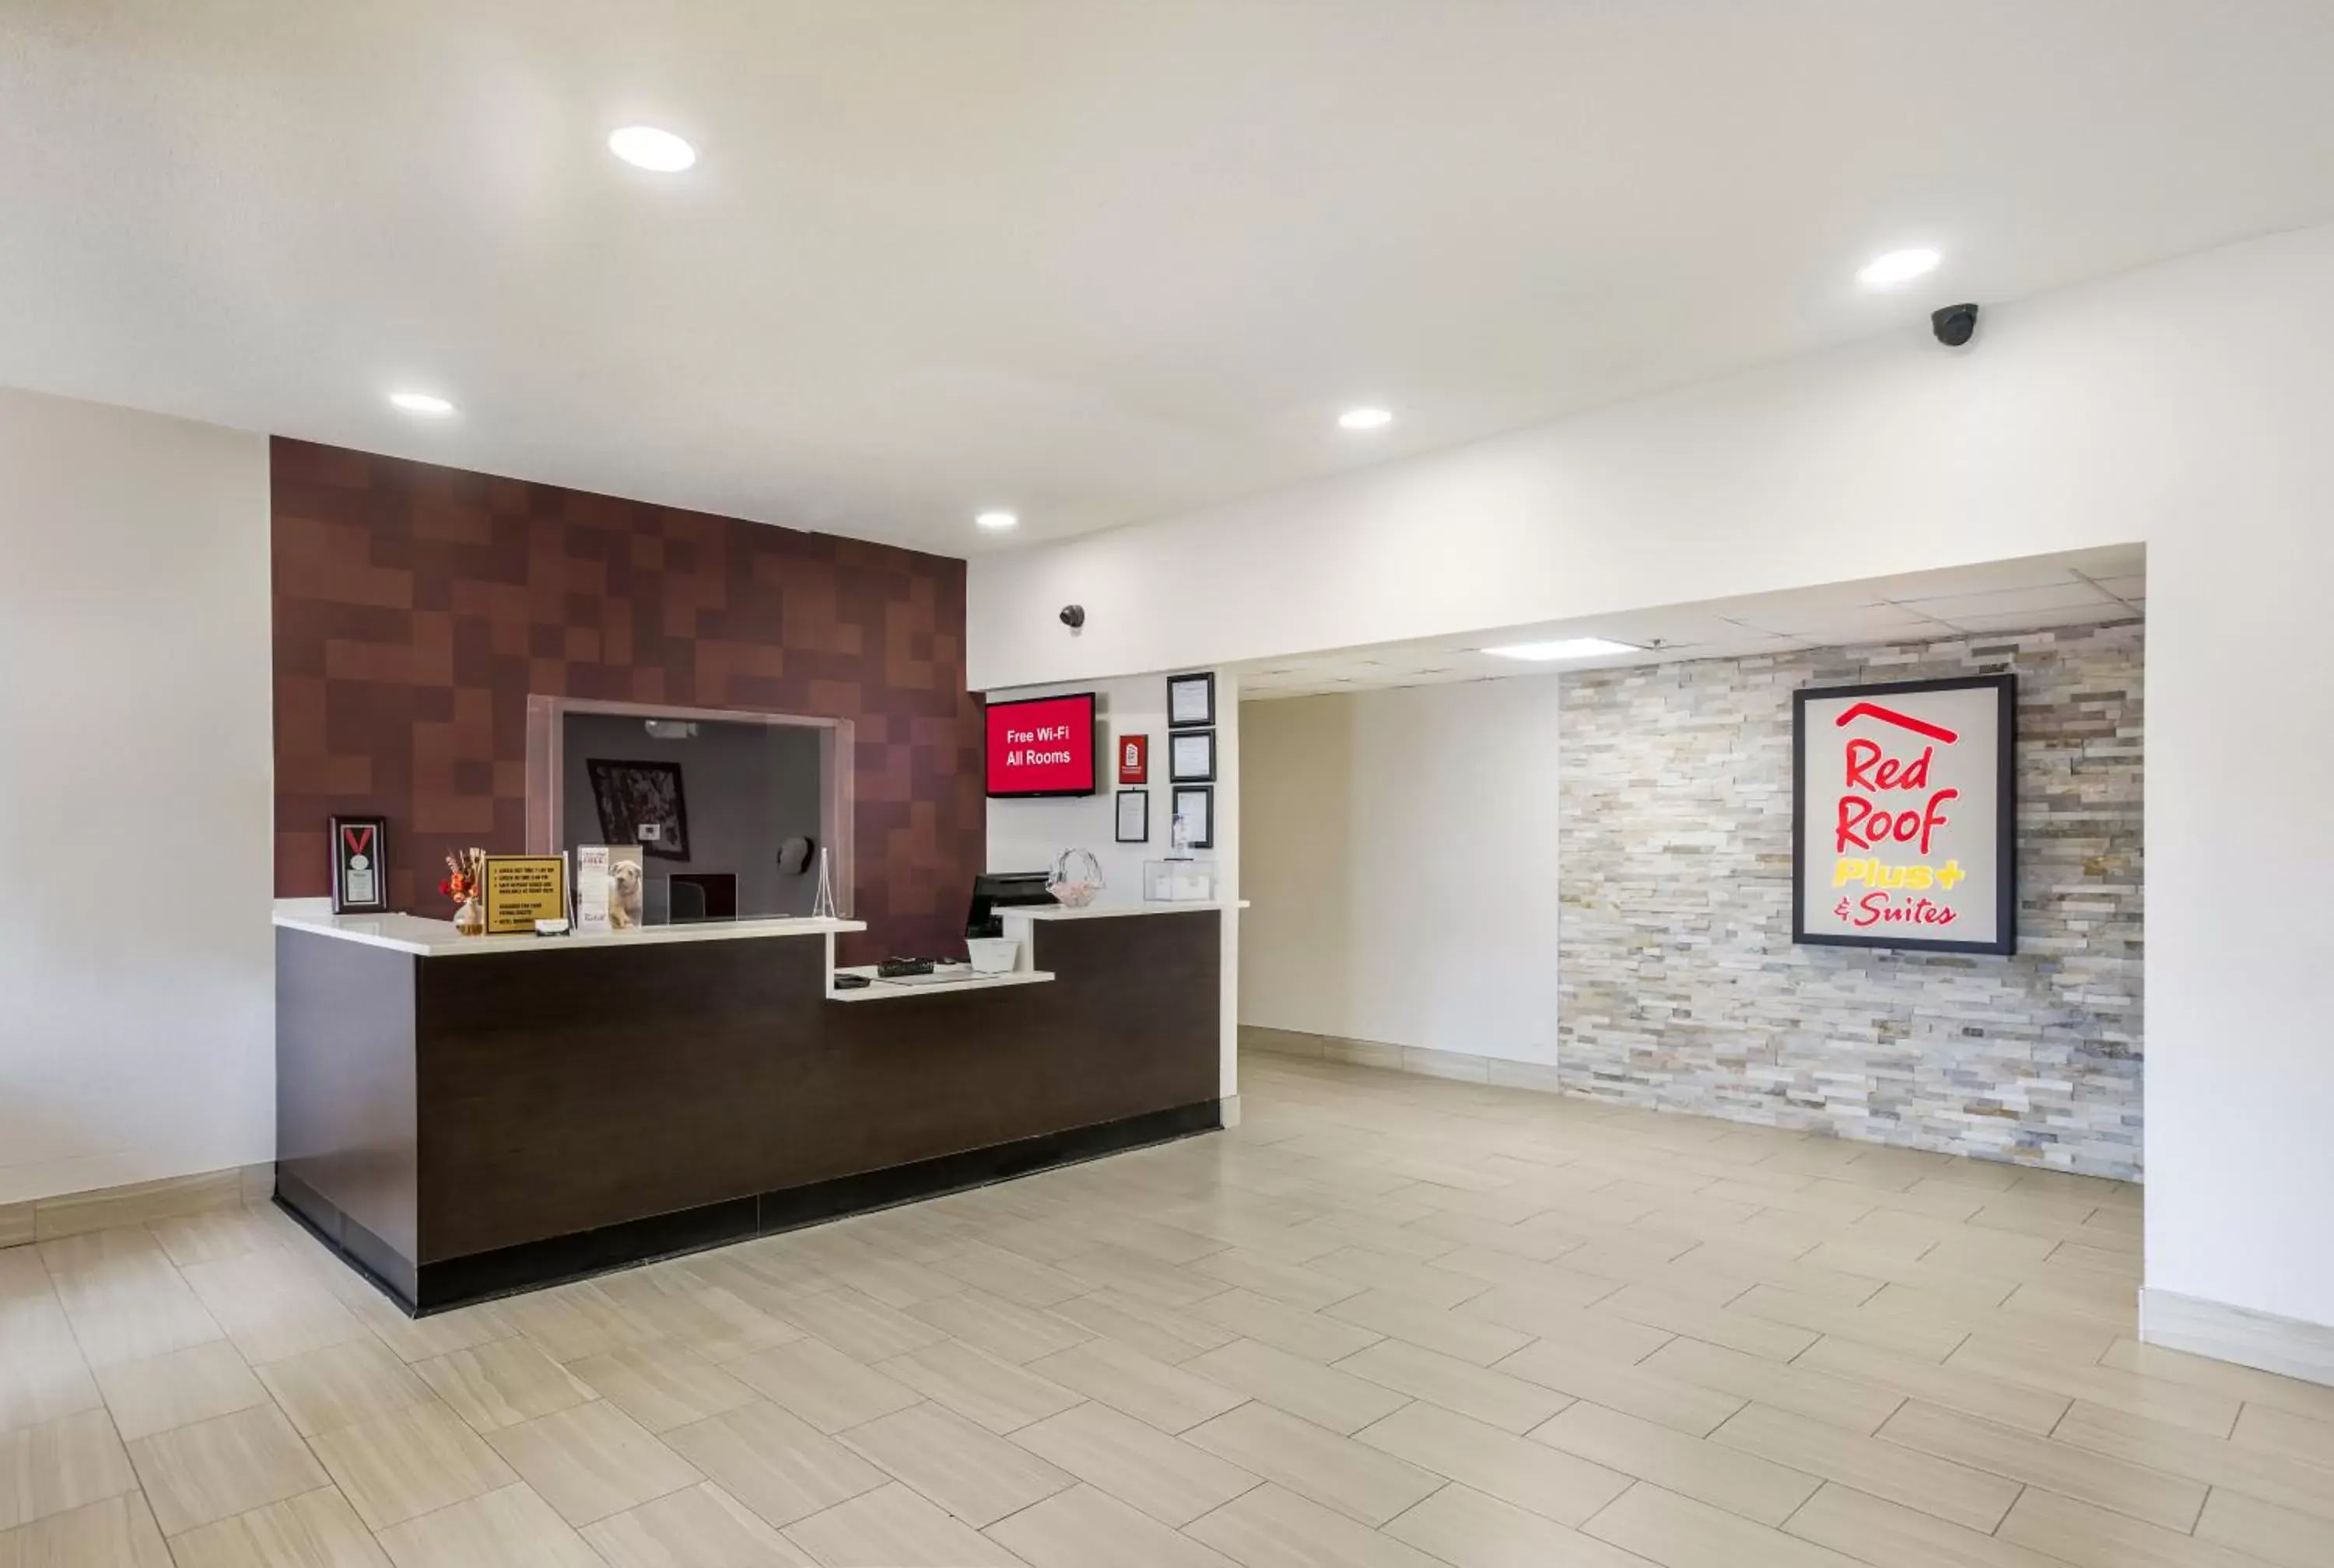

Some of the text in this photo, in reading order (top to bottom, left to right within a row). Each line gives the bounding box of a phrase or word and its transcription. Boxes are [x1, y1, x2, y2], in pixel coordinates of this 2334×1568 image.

[1007, 725, 1070, 744] Free Wi-Fi
[1006, 749, 1071, 766] All Rooms
[1845, 738, 1933, 793] Red
[1835, 788, 1958, 855] Roof
[1833, 891, 1957, 926] & Suites
